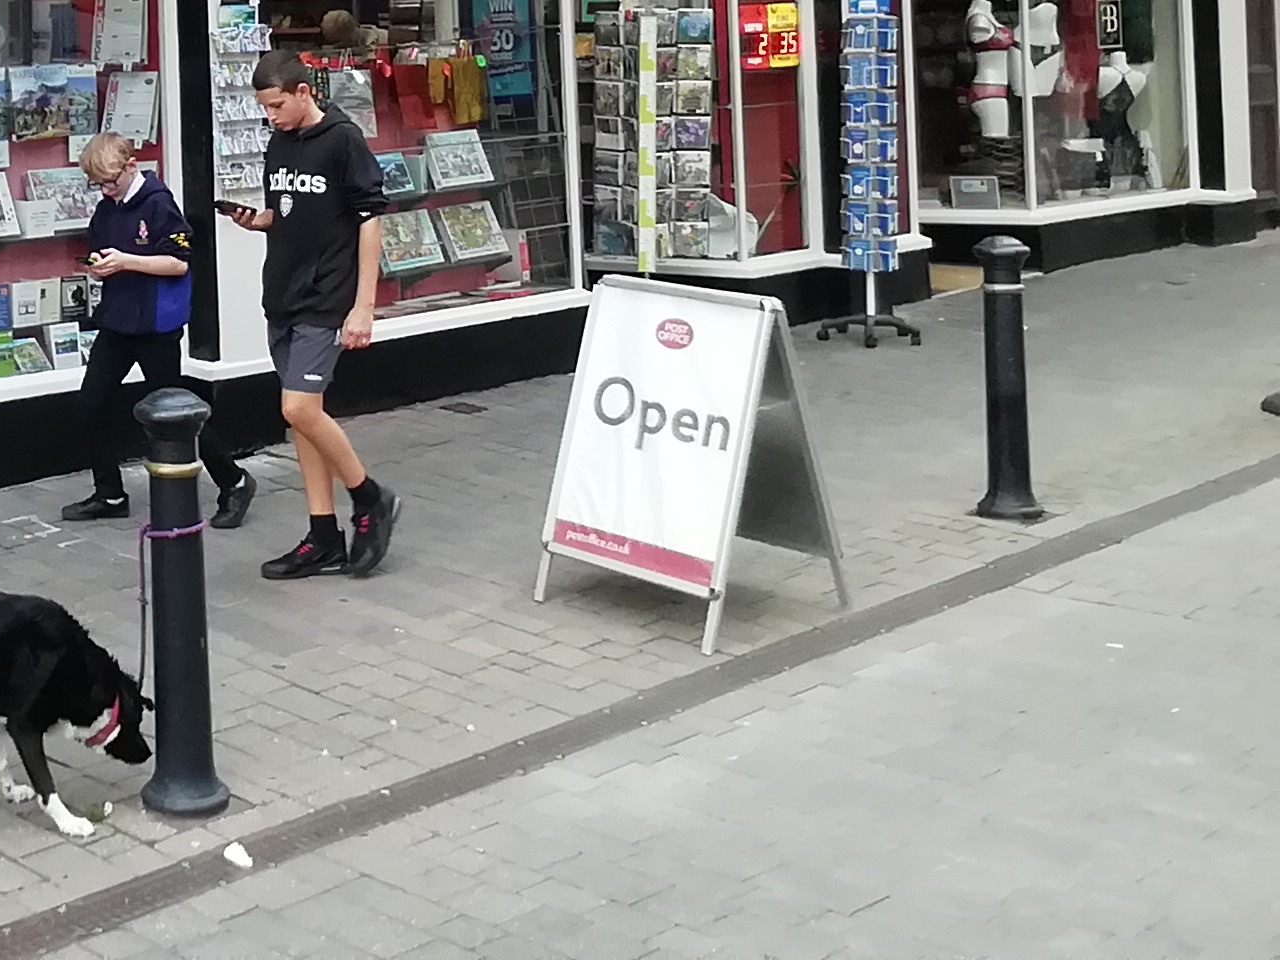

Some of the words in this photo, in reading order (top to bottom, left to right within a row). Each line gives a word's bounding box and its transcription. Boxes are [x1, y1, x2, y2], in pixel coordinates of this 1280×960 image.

[758, 33, 769, 55] 2
[779, 31, 798, 54] 35
[657, 330, 691, 345] OFFICE
[664, 322, 689, 335] POST
[593, 375, 731, 452] Open
